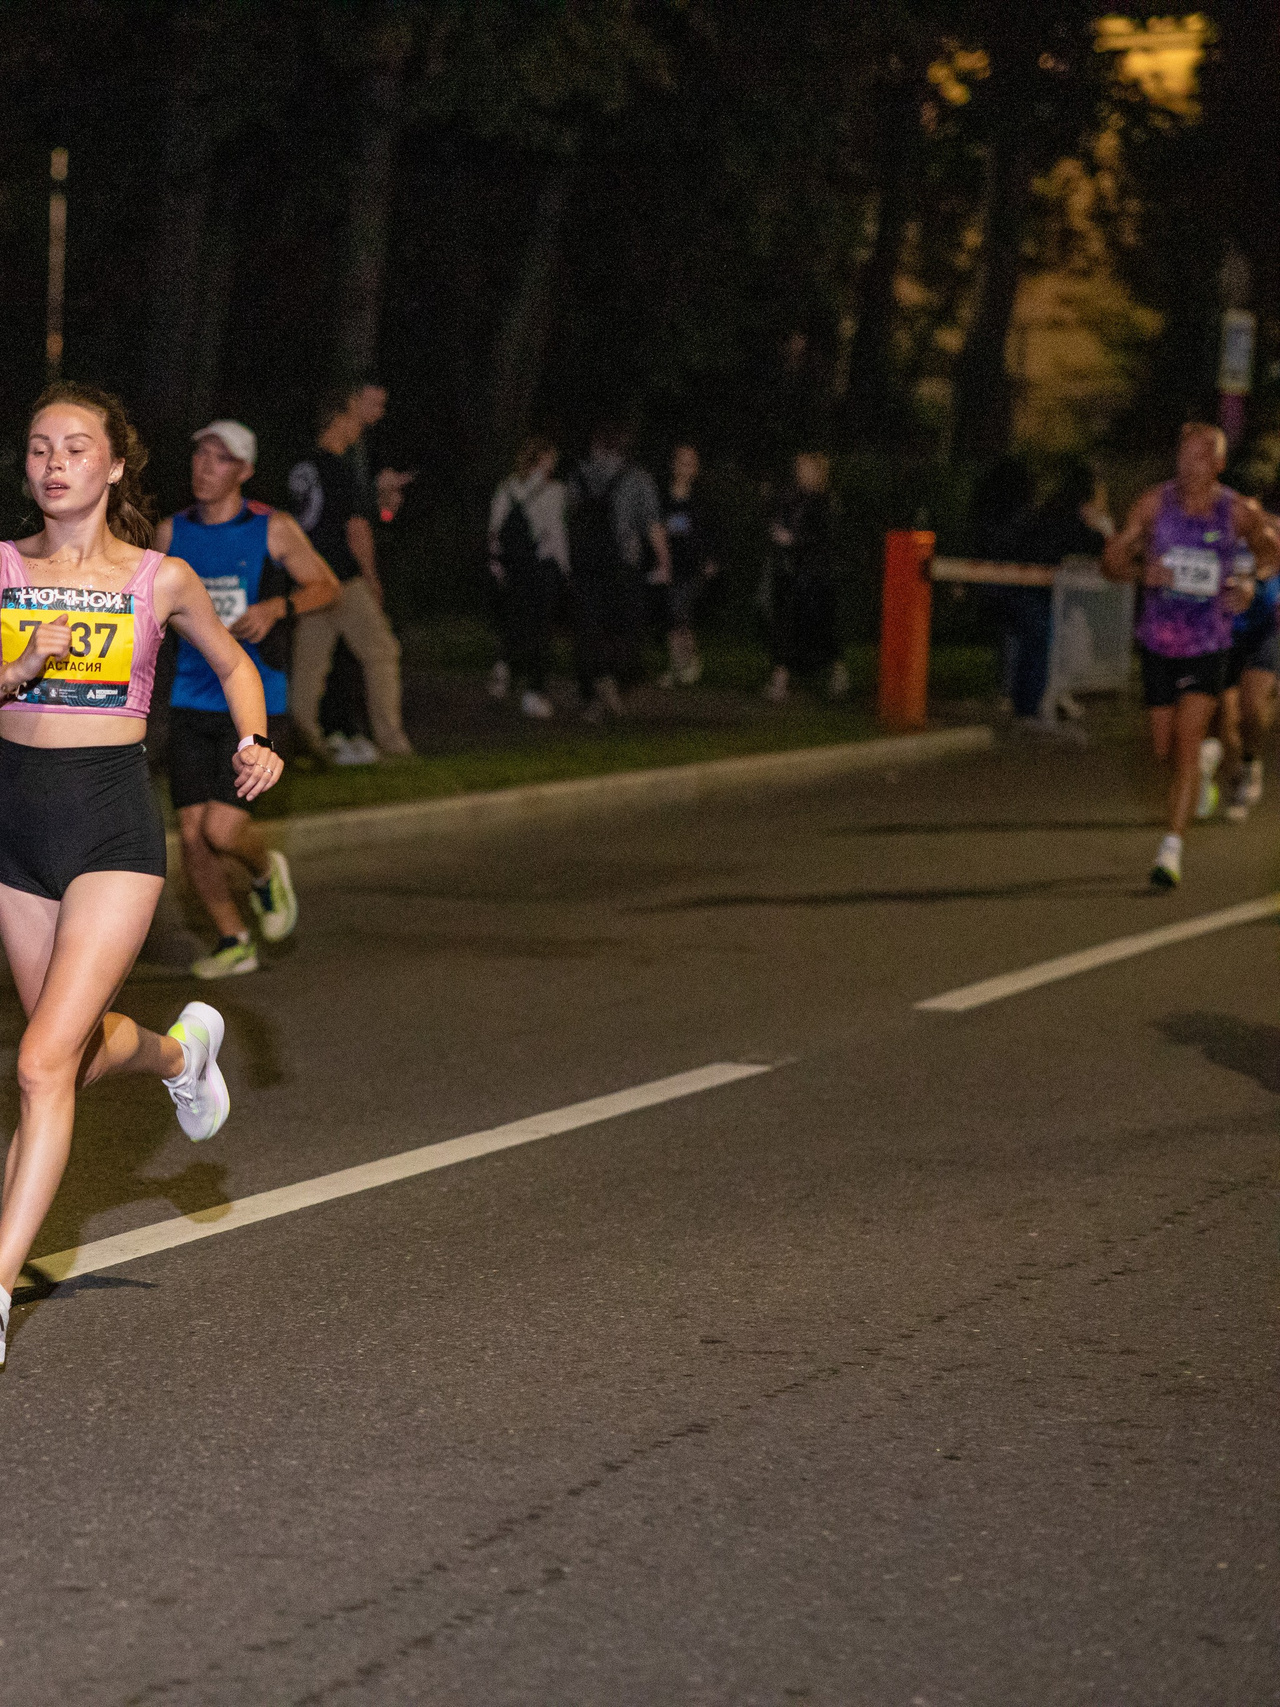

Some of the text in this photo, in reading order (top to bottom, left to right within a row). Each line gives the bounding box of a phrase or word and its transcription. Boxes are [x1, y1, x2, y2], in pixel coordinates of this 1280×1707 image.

[16, 587, 125, 610] НОЧНОЙ
[19, 619, 118, 659] 737
[44, 660, 102, 673] АСТАСИЯ
